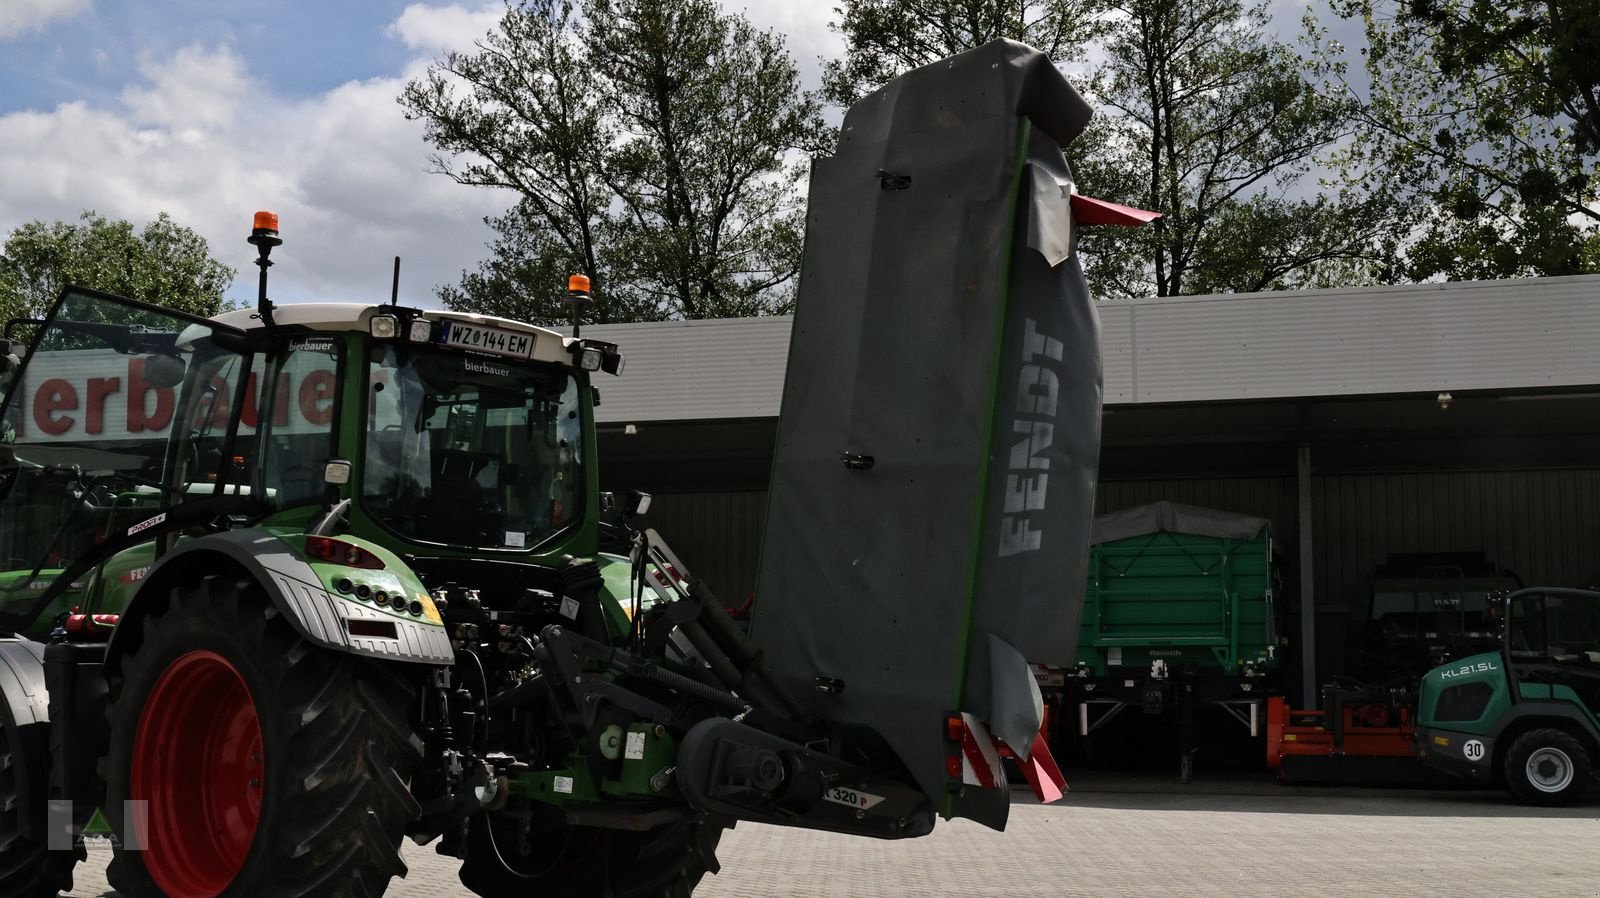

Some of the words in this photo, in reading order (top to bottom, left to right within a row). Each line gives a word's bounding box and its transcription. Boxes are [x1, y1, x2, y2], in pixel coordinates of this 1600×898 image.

[288, 337, 332, 351] bierbauer
[452, 326, 472, 344] WZ
[483, 331, 505, 350] 144
[508, 335, 528, 353] EM
[464, 358, 510, 376] bierbauer
[998, 318, 1064, 557] FENDT
[1441, 662, 1496, 679] KL21.5L
[1466, 743, 1481, 757] 30
[833, 788, 857, 804] 320
